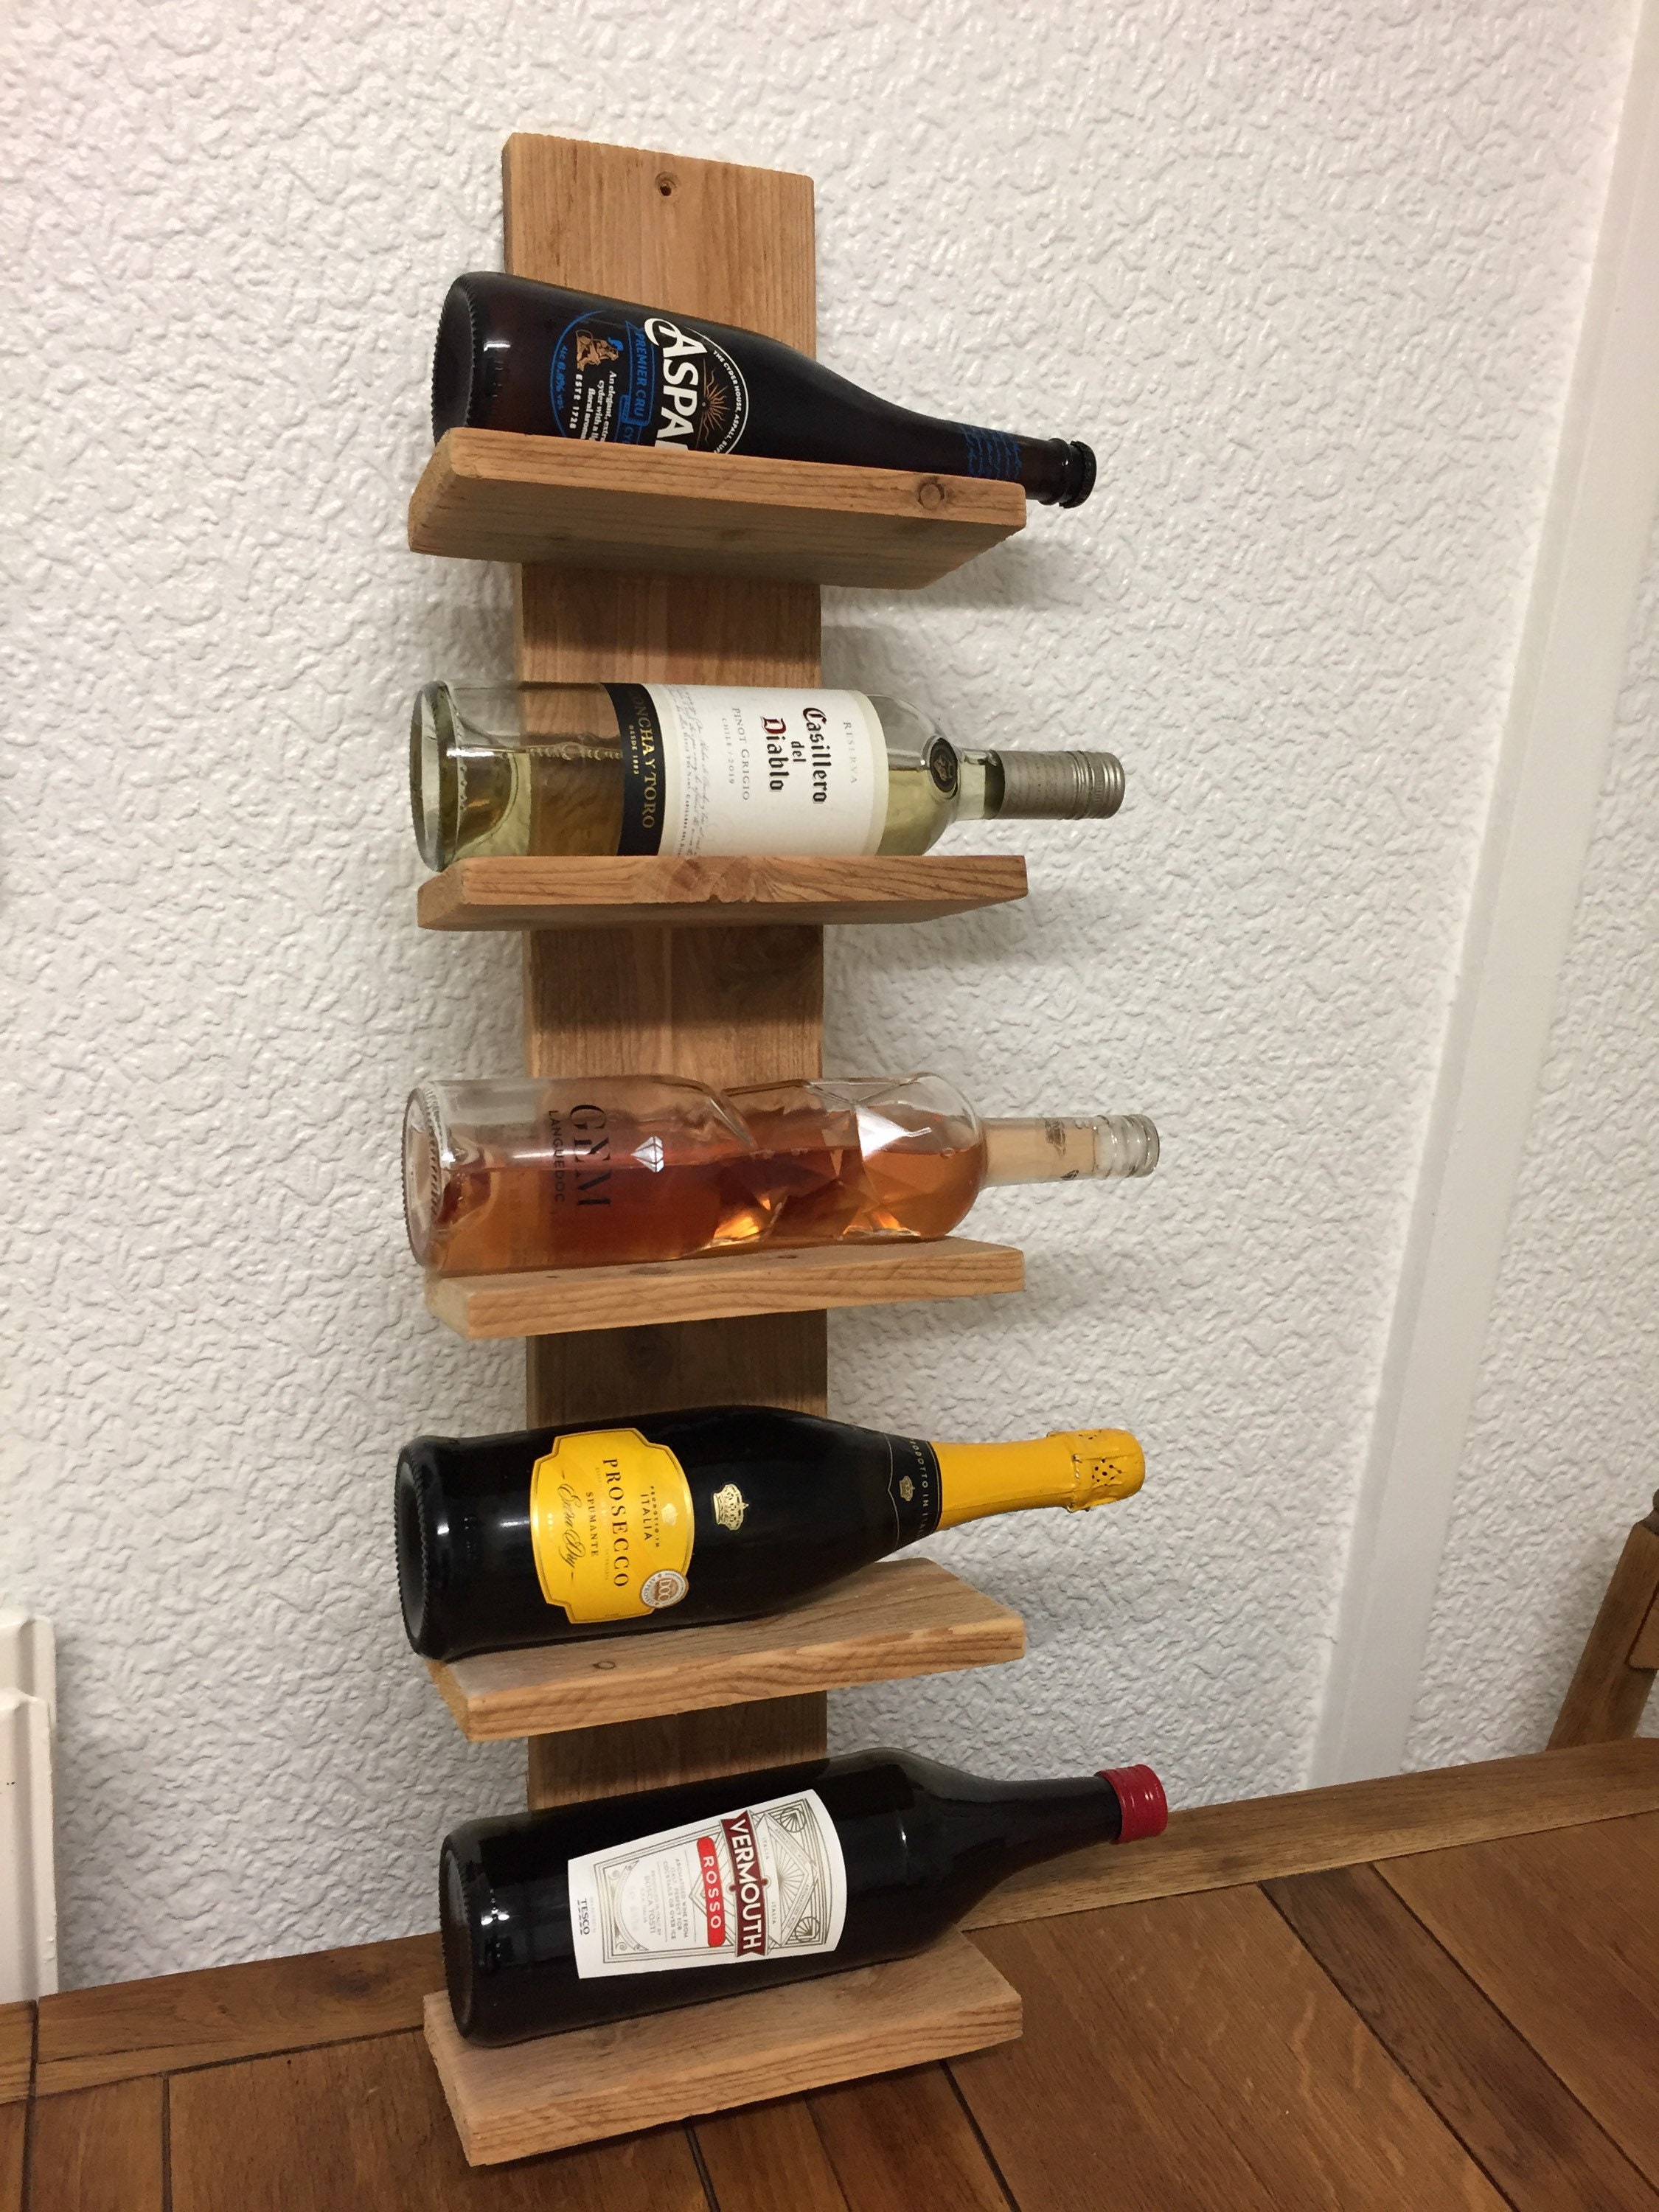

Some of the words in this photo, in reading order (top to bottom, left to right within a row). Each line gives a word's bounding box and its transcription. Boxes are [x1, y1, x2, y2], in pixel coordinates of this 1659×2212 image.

[609, 371, 616, 384] An
[634, 331, 646, 386] PREMIER
[713, 350, 724, 363] THE
[724, 363, 737, 385] CYDER
[586, 388, 596, 411] floral
[594, 406, 602, 425] with
[605, 386, 616, 420] elegant,
[634, 389, 646, 417] CRU
[629, 725, 637, 750] DESDE
[630, 690, 655, 755] CONCHA
[722, 718, 732, 747] CHILE
[644, 759, 655, 770] Y
[731, 707, 747, 743] PINOT
[741, 749, 750, 800] GRIGIO
[761, 717, 790, 792] Diablo
[791, 741, 806, 762] del
[803, 707, 831, 803] Casillero
[844, 722, 858, 783] RESERVA
[642, 771, 656, 829] TORO
[549, 1110, 565, 1203] LANGUEDOC
[641, 1493, 653, 1541] ITALIA
[650, 1486, 660, 1534] PRODOTTO
[655, 1537, 660, 1548] IN
[922, 1494, 928, 1506] IN
[585, 1492, 599, 1557] SPUMANTE
[602, 1458, 629, 1587] PROSECCO
[559, 1529, 586, 1568] Dry
[668, 1898, 674, 1907] OR
[703, 1856, 721, 1930] ROSSO
[730, 1818, 762, 1950] VERMOUTH
[580, 1899, 590, 1935] TESCO
